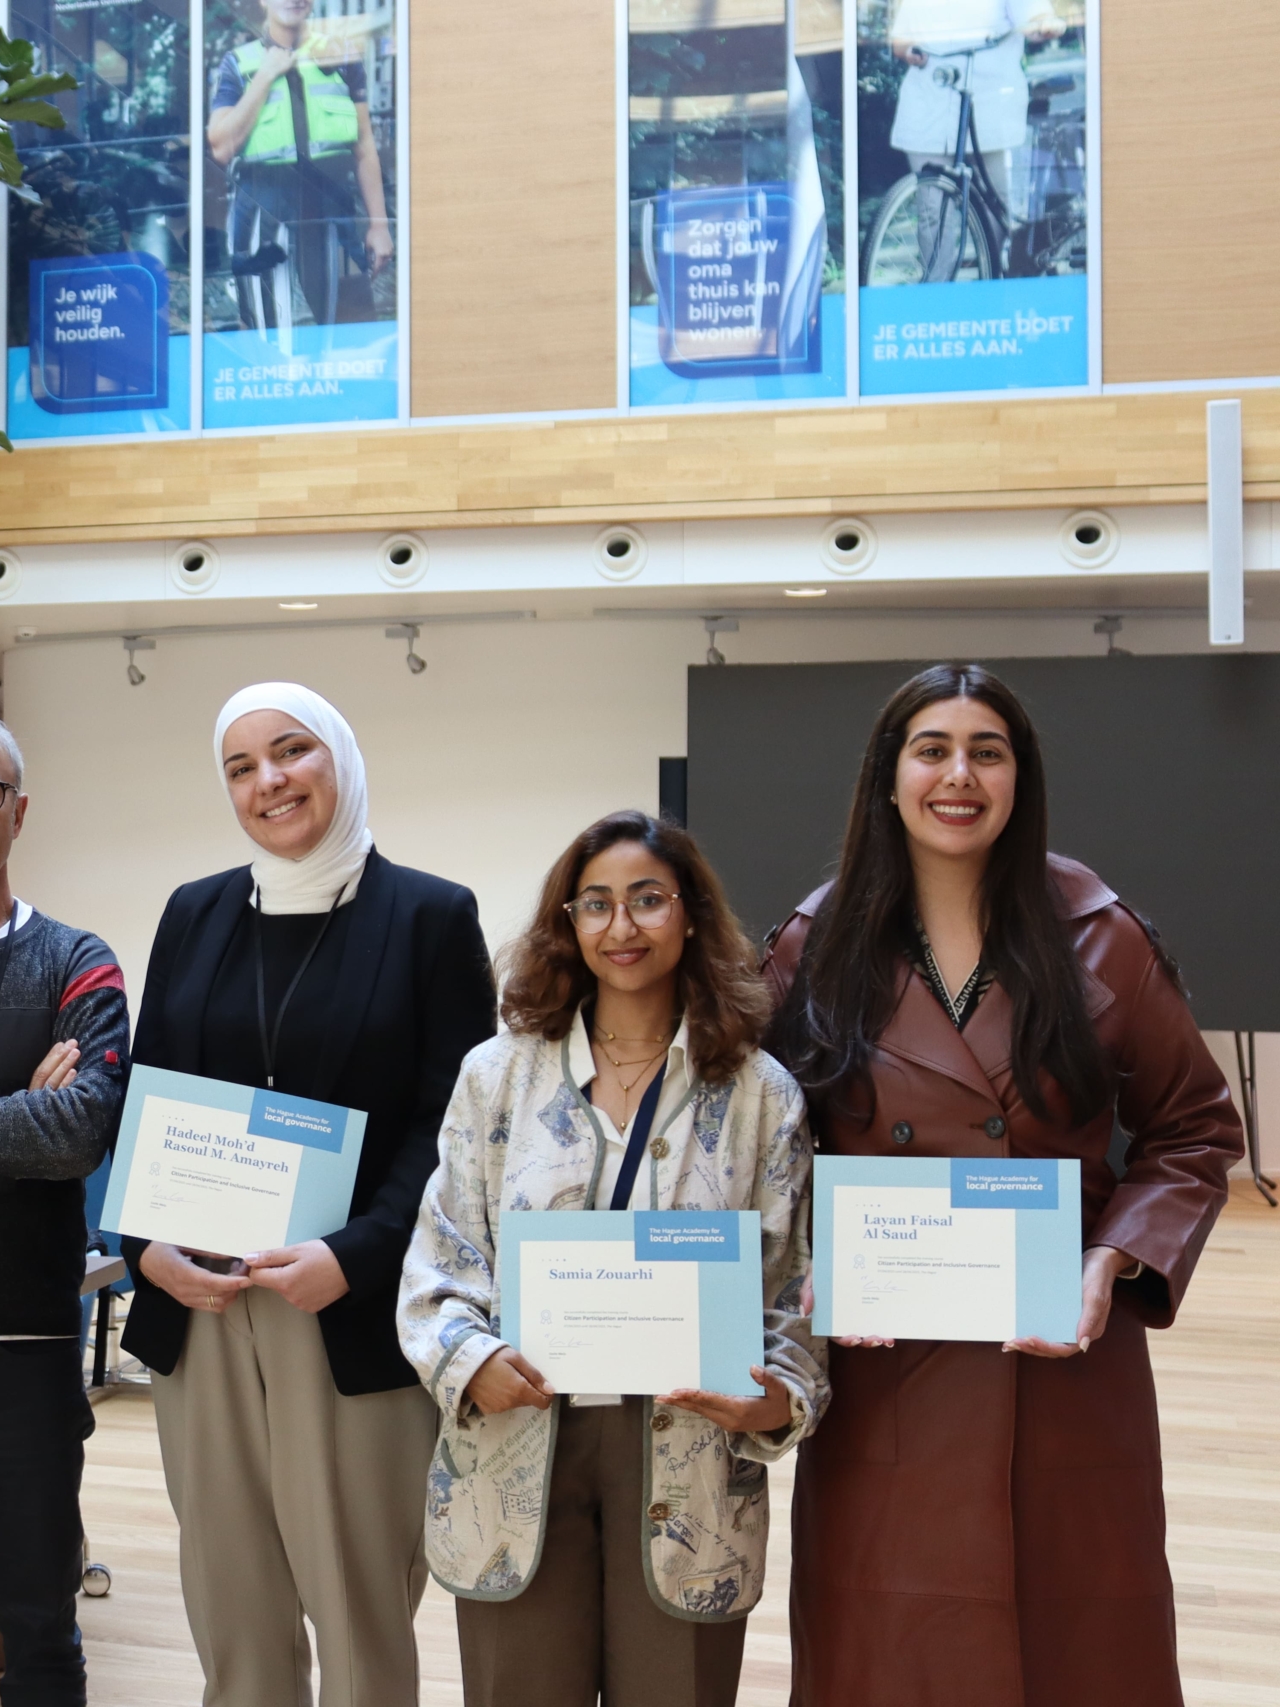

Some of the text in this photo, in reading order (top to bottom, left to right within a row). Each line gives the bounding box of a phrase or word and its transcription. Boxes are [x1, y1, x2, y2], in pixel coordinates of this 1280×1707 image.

[688, 219, 761, 238] Zorgen
[688, 239, 778, 260] dat jouw
[688, 263, 732, 278] oma
[55, 284, 117, 305] Je wijk
[688, 280, 780, 299] thuis kan
[55, 305, 102, 324] veilig
[688, 302, 756, 324] blijven
[55, 324, 125, 342] houden.
[874, 316, 1073, 341] JE GEMEENTE DOET
[874, 338, 1023, 361] ER ALLES AAN.
[214, 359, 387, 383] JE GEMEENTE DOET
[214, 380, 344, 400] ER ALLES AAN.
[264, 1113, 332, 1133] local governance
[265, 1106, 276, 1114] The
[277, 1109, 294, 1119] Hague
[295, 1111, 320, 1124] Academy
[166, 1125, 211, 1144] Hadeel
[163, 1138, 208, 1158] Rasoul
[211, 1148, 227, 1161] M.
[230, 1152, 289, 1174] Amayreh
[171, 1170, 187, 1178] Citizen
[188, 1174, 218, 1184] Participation
[230, 1182, 250, 1190] Inclusive
[251, 1186, 280, 1196] Governance
[966, 1182, 1043, 1192] local governance
[864, 1214, 953, 1228] Layan Faisal
[650, 1234, 725, 1244] local governance
[662, 1228, 681, 1236] Hague
[682, 1228, 710, 1236] Academy
[863, 1228, 917, 1240] Al Saud
[549, 1269, 653, 1280] Samia Zouarhi
